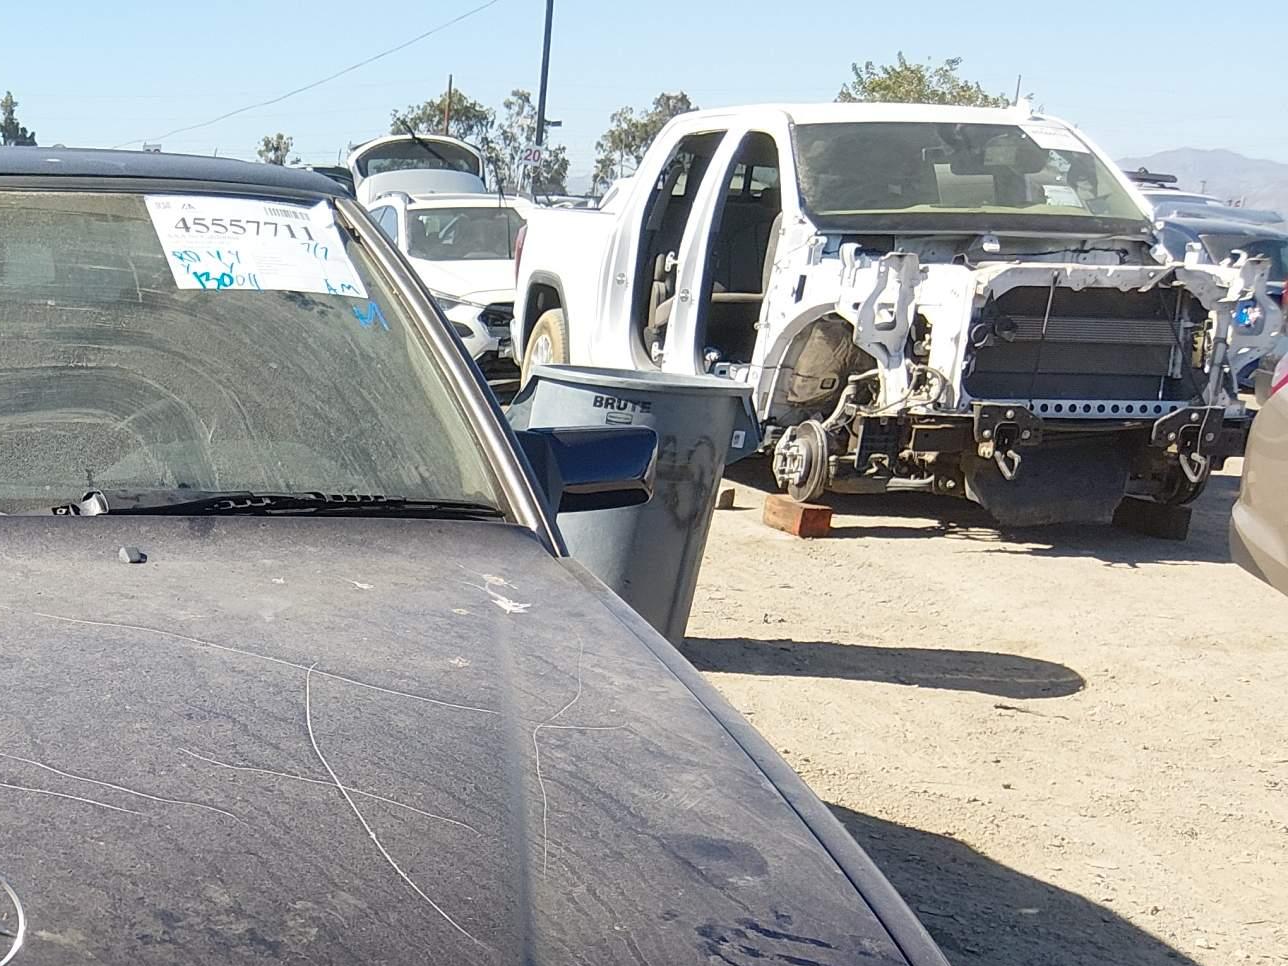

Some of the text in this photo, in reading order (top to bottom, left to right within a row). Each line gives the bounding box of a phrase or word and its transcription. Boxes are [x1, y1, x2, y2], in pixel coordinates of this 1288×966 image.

[523, 148, 541, 162] 20
[174, 216, 314, 241] 45557711
[592, 394, 652, 413] BRUTE
